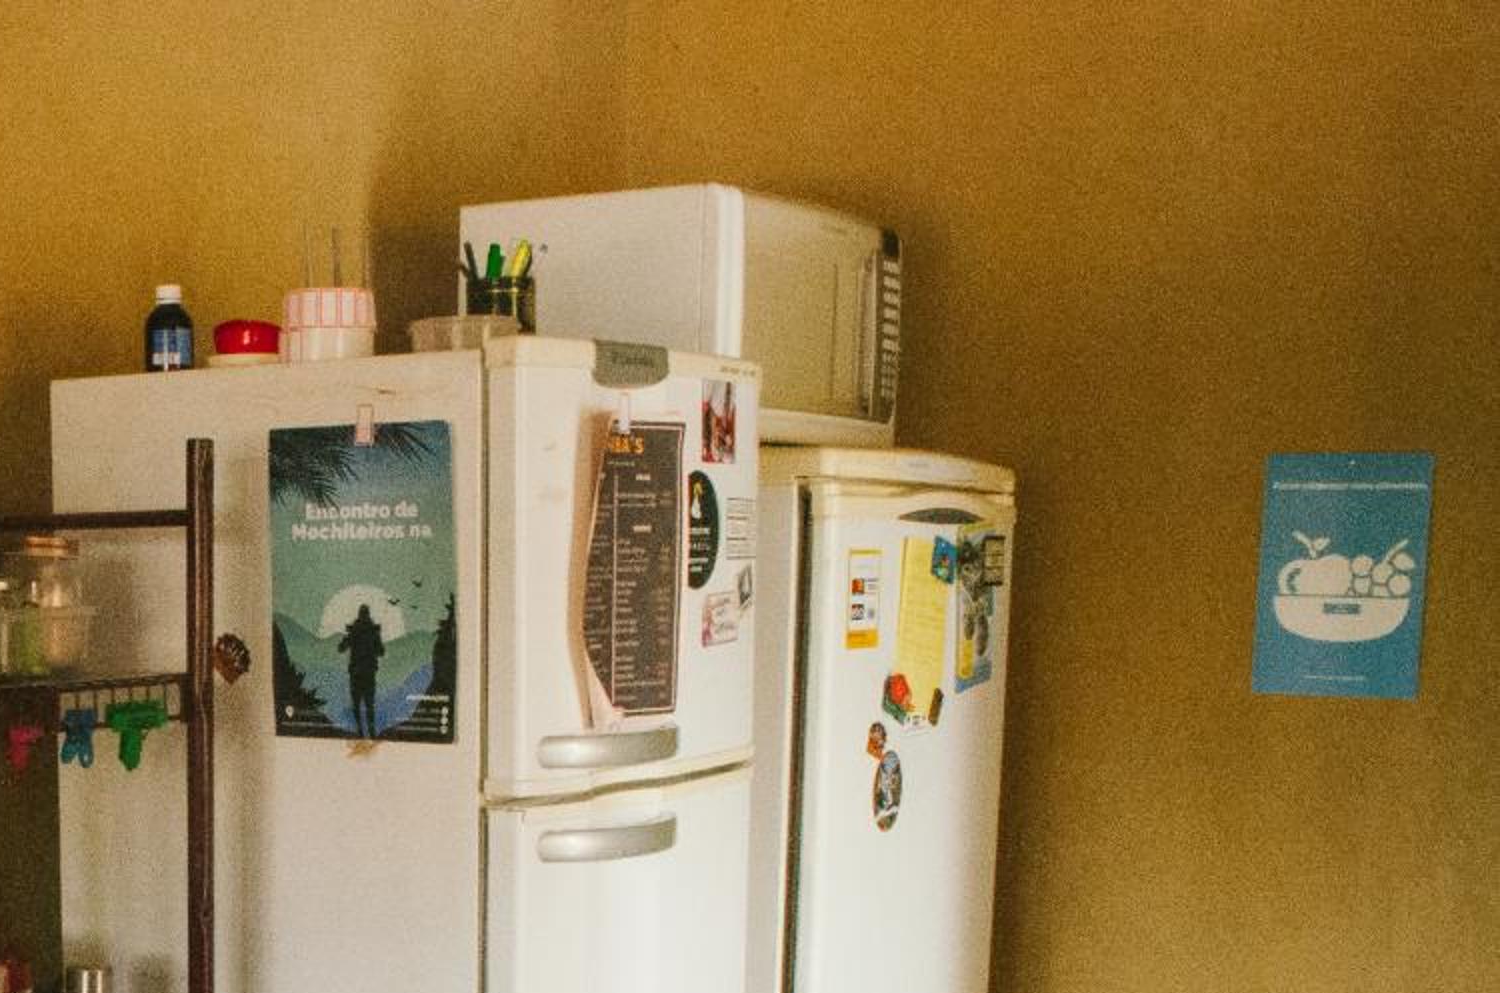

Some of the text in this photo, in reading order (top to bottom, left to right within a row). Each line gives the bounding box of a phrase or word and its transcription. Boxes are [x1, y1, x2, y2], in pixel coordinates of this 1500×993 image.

[305, 500, 419, 520] Encontro de
[291, 521, 433, 541] Mochileiros na
